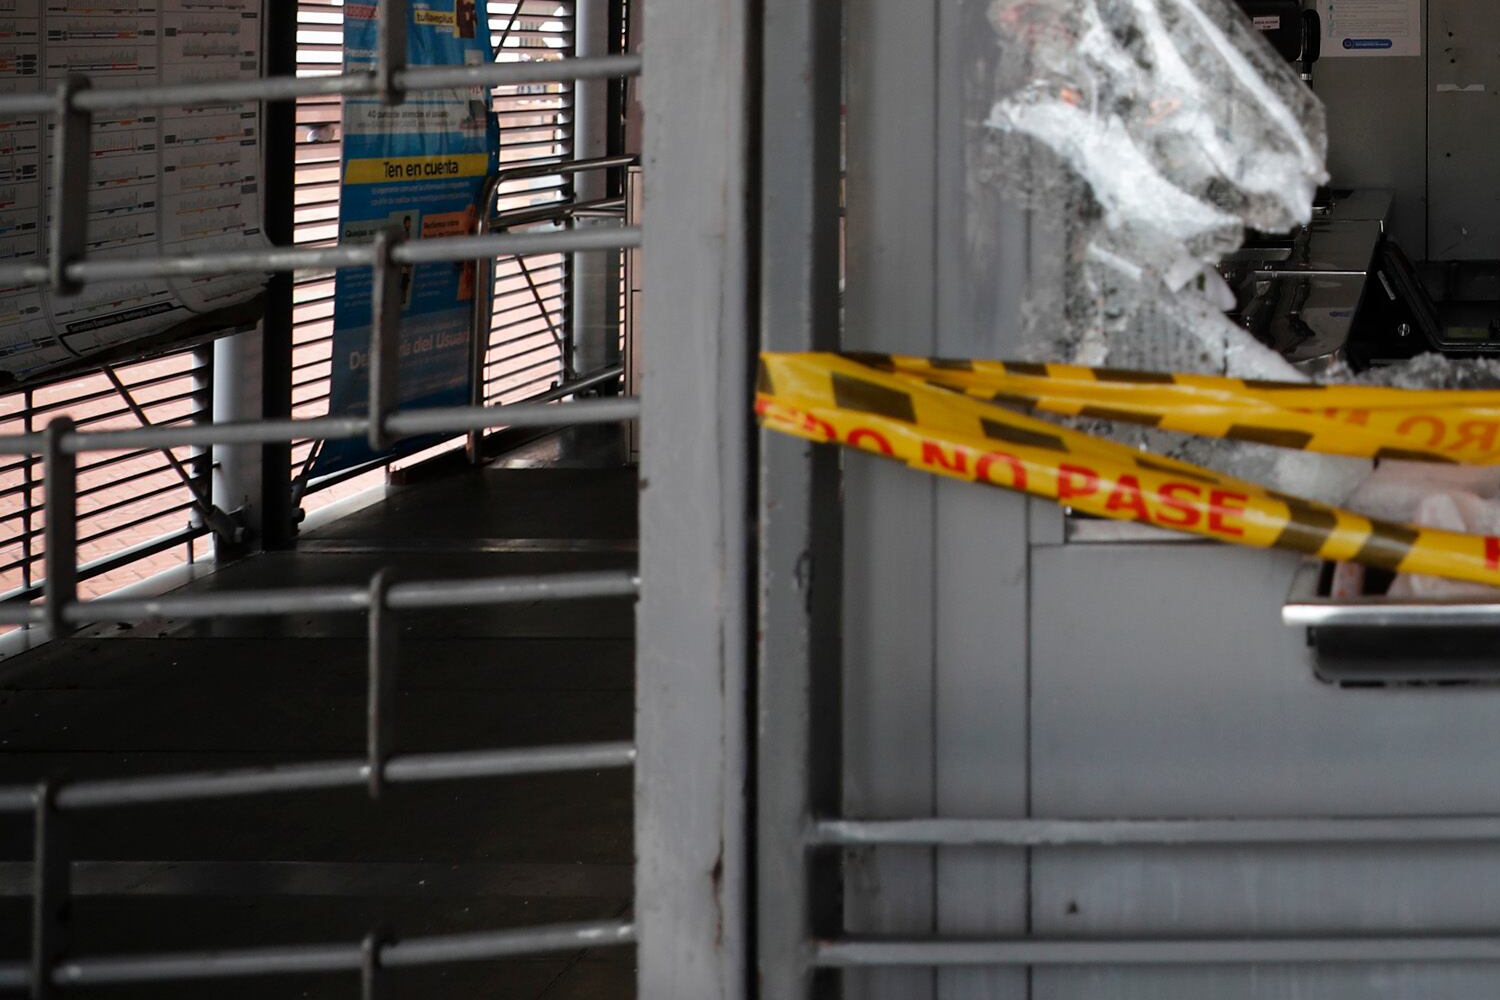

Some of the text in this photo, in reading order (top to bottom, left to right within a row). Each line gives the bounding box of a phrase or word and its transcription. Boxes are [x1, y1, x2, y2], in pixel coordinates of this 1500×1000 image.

[384, 161, 459, 178] Ten en cuenta
[1058, 461, 1249, 535] PASE
